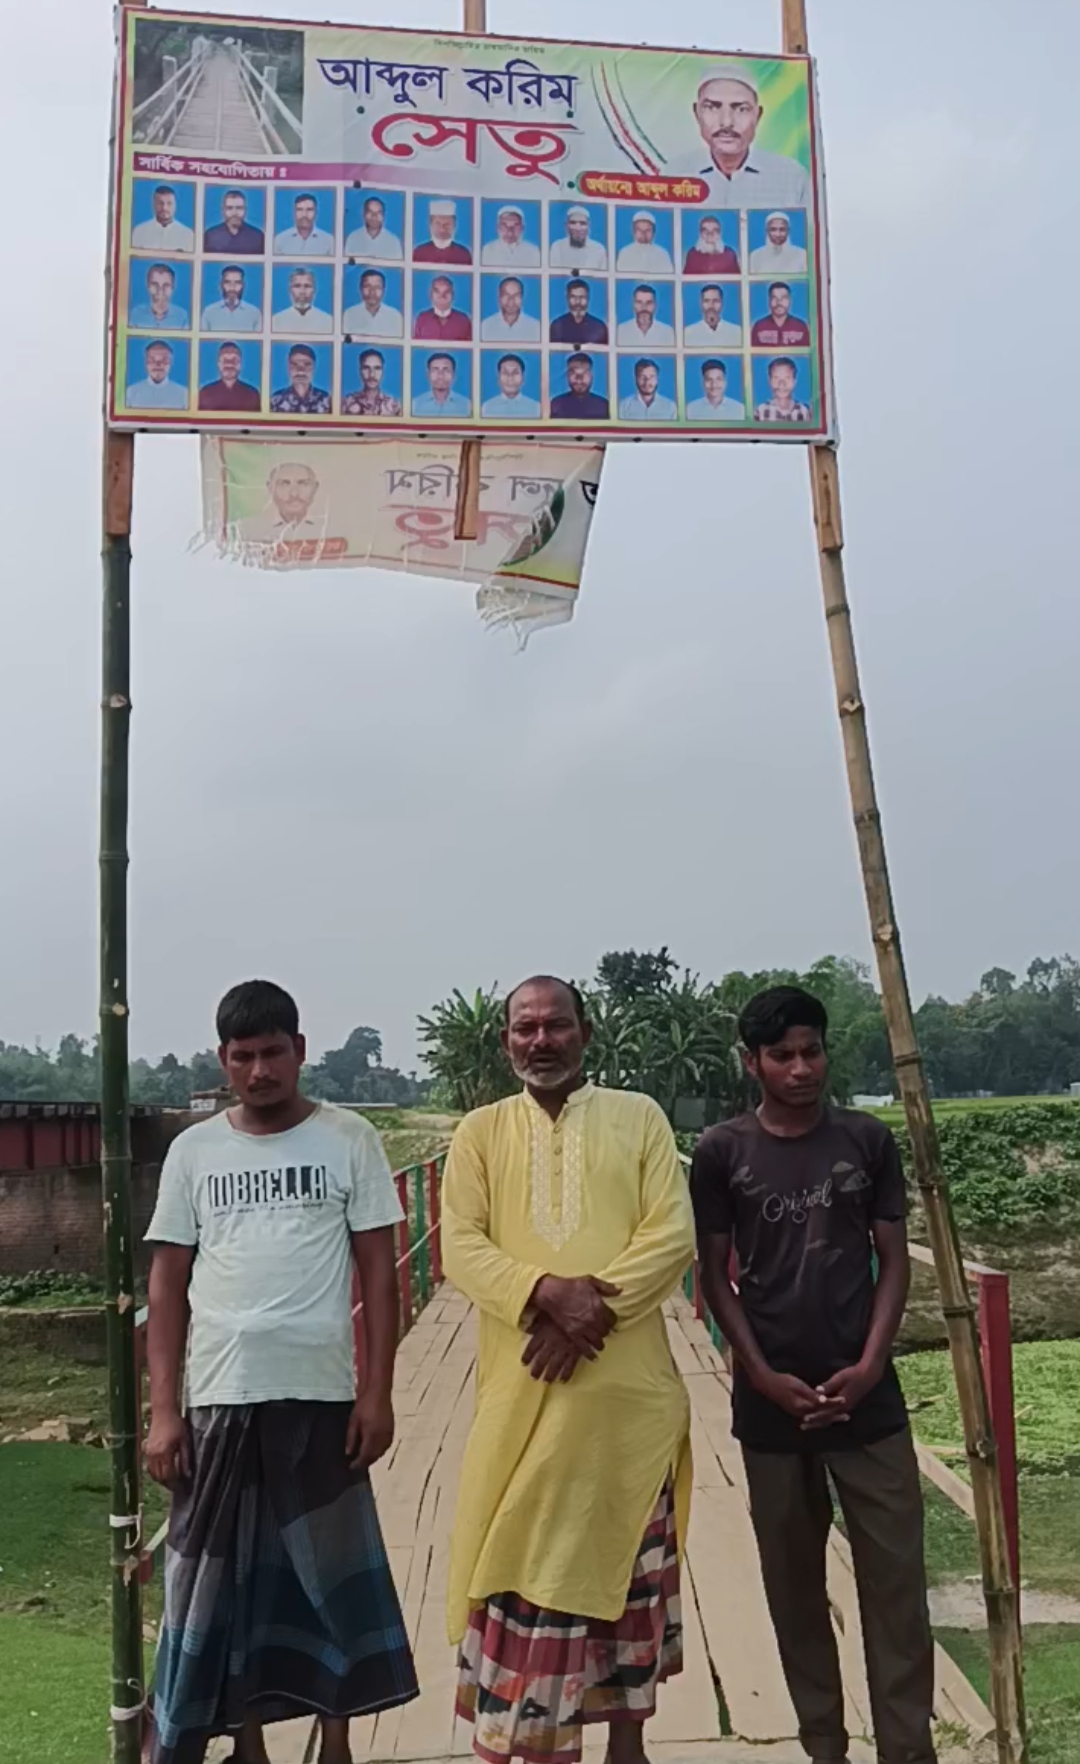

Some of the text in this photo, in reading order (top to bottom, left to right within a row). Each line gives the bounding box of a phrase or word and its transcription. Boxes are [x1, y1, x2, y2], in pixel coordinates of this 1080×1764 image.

[317, 57, 579, 108] আব্দুল করিম
[138, 155, 185, 172] সার্বিক
[371, 112, 579, 185] সেতু
[762, 1178, 833, 1224] Original
